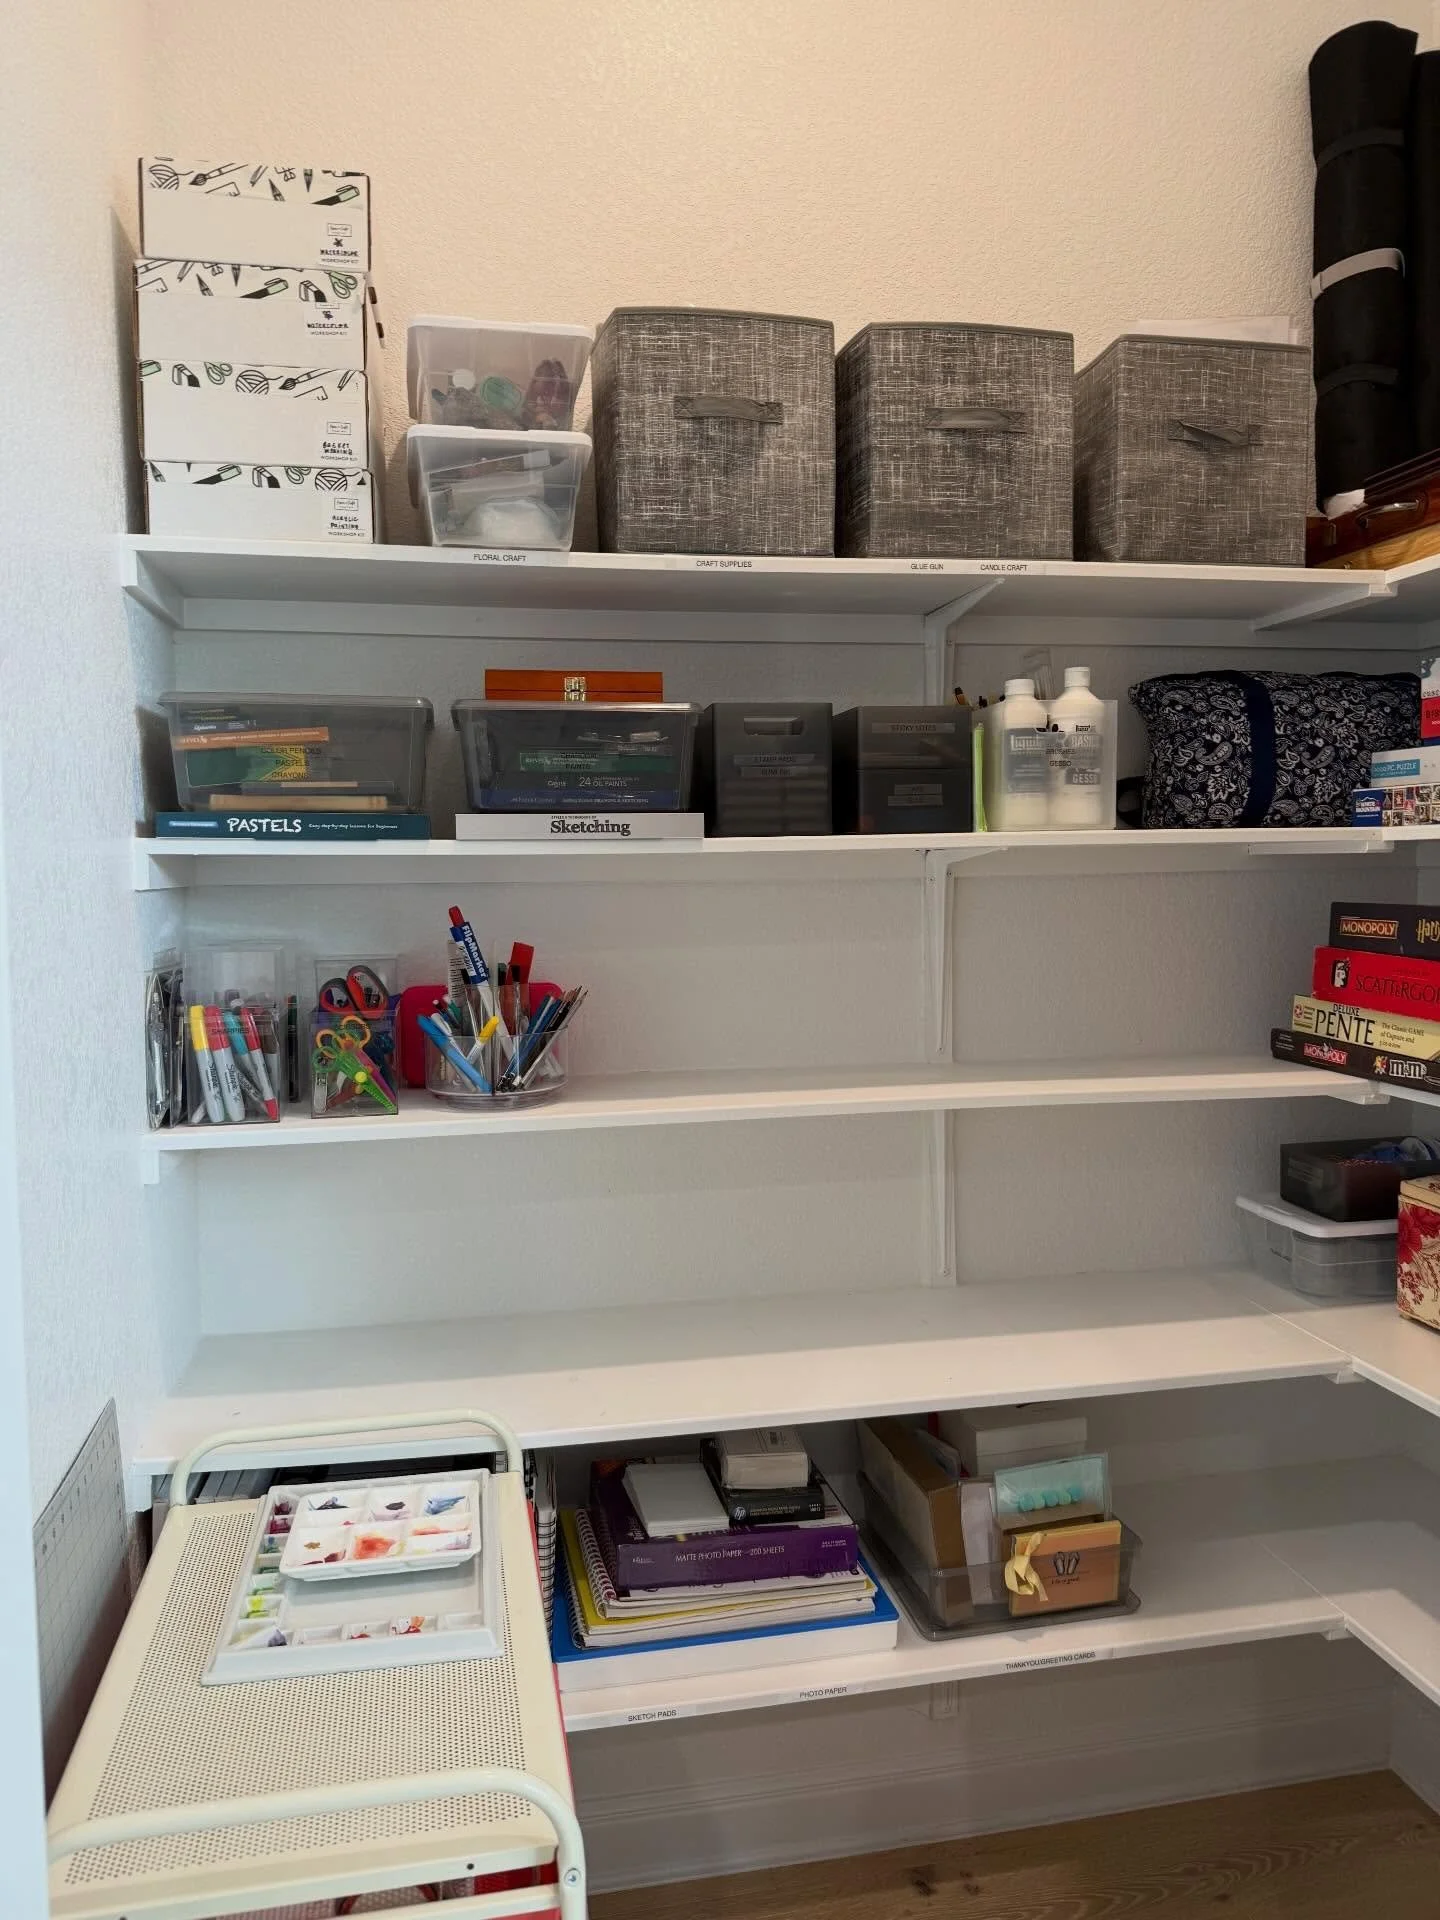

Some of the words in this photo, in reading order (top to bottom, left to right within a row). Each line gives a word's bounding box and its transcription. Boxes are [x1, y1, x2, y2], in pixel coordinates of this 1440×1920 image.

[473, 553, 502, 561] FLORAL
[502, 554, 527, 562] CRAFT
[696, 560, 719, 568] CRAFT
[719, 560, 753, 568] SUPPLIES
[929, 563, 944, 571] GUN
[980, 563, 1005, 572] CANDLE
[1006, 564, 1028, 572] CRAFT
[1396, 762, 1418, 770] PUZZLE
[578, 776, 592, 787] 24
[226, 817, 302, 833] PASTELS
[550, 820, 632, 837] Sketching
[1341, 921, 1397, 937] MONOPOLY
[462, 924, 487, 979] FlipMarker
[1332, 1002, 1361, 1017] DELUXE
[1313, 1008, 1376, 1047] PENTE
[1303, 1042, 1348, 1065] MONOPOLY
[734, 1506, 747, 1520] hp
[675, 1553, 697, 1563] MATTE
[698, 1551, 722, 1562] PHOTO
[722, 1548, 743, 1560] PAPER
[762, 1544, 786, 1555] SHEETS
[1073, 1651, 1097, 1661] CARDS
[799, 1688, 824, 1700] PHOTO
[824, 1686, 848, 1697] PAPER
[627, 1712, 656, 1723] SKETCH
[657, 1709, 678, 1719] PADS
